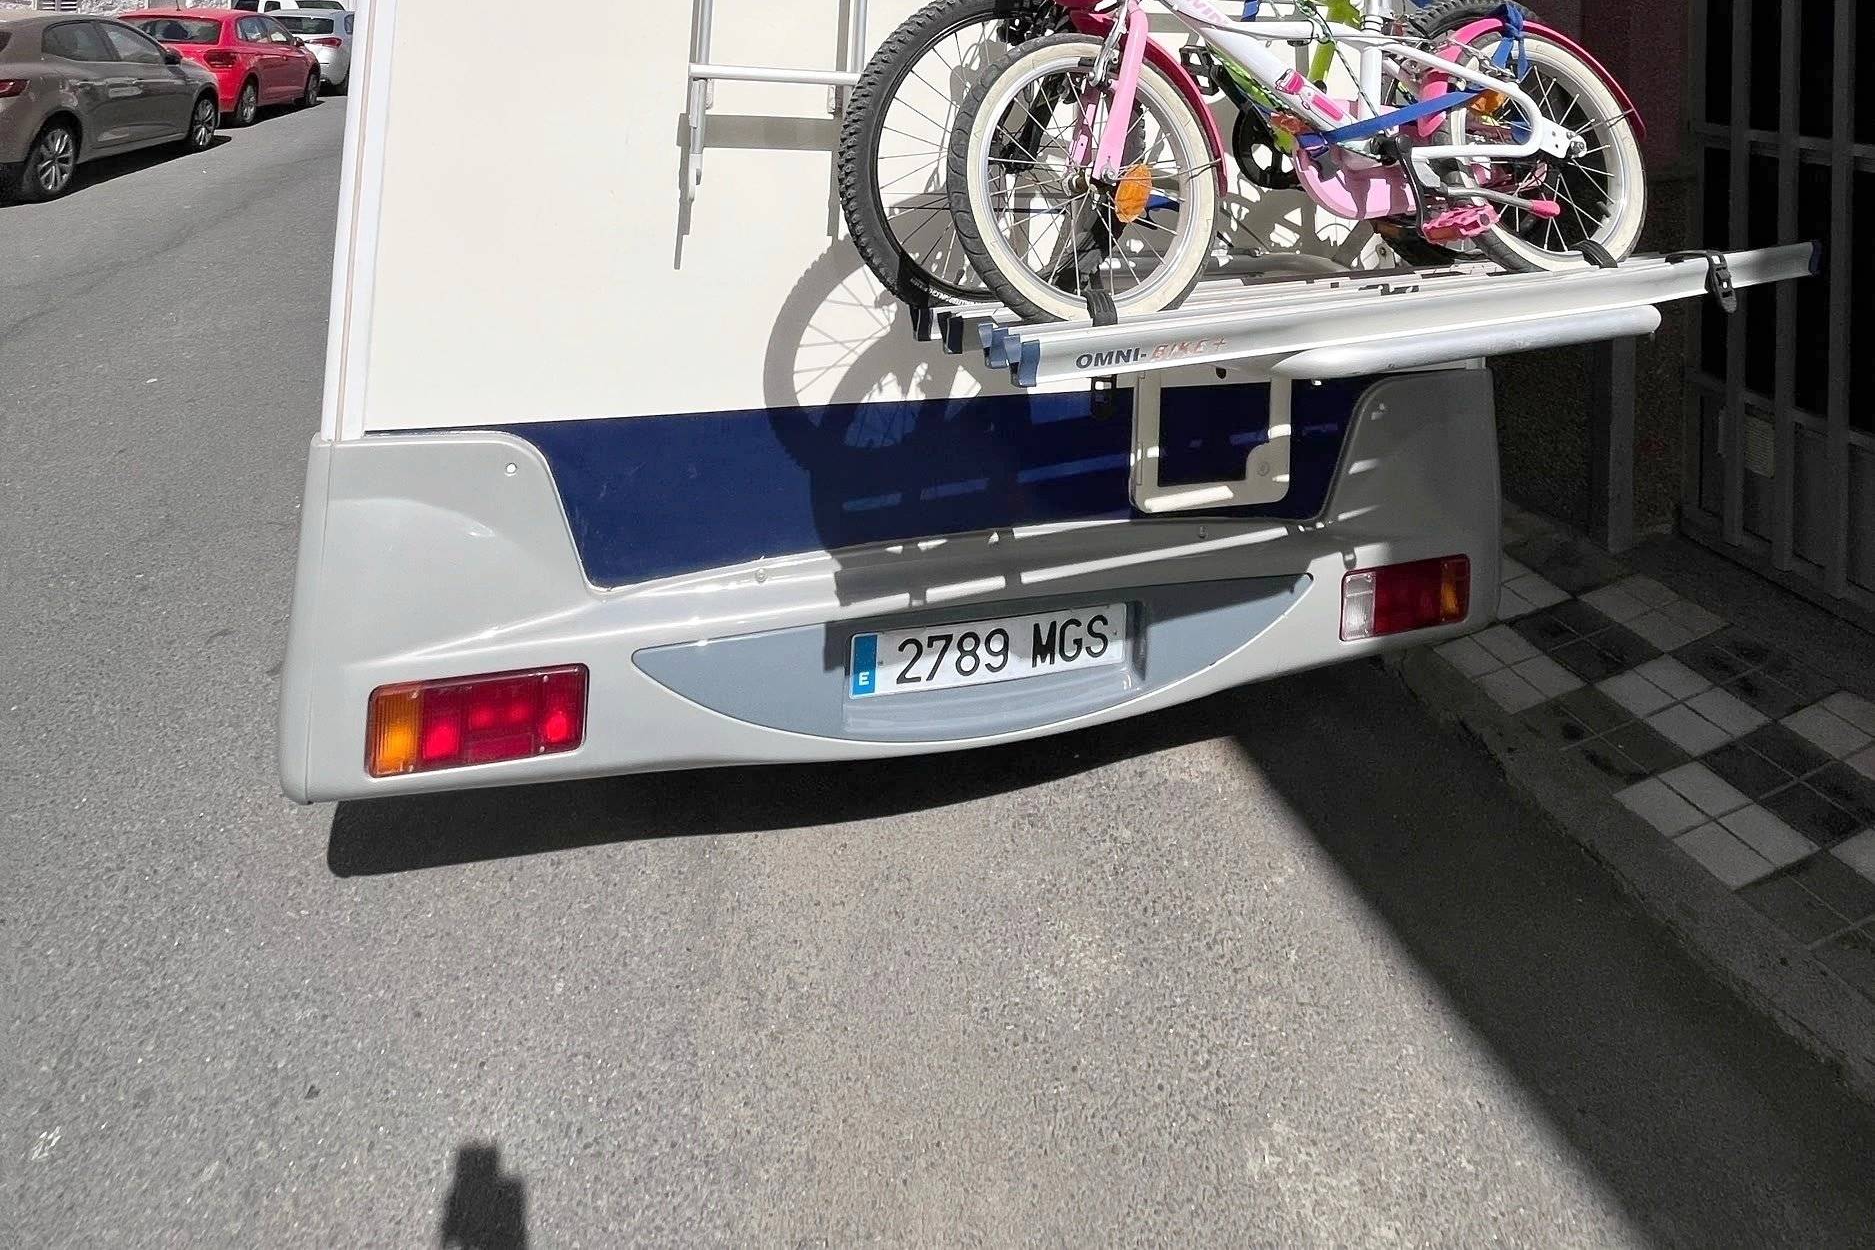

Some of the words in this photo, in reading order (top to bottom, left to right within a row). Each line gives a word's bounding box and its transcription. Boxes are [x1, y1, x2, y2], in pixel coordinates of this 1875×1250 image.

[896, 627, 1010, 685] 2789
[1031, 614, 1109, 668] MGS
[858, 671, 870, 686] E
